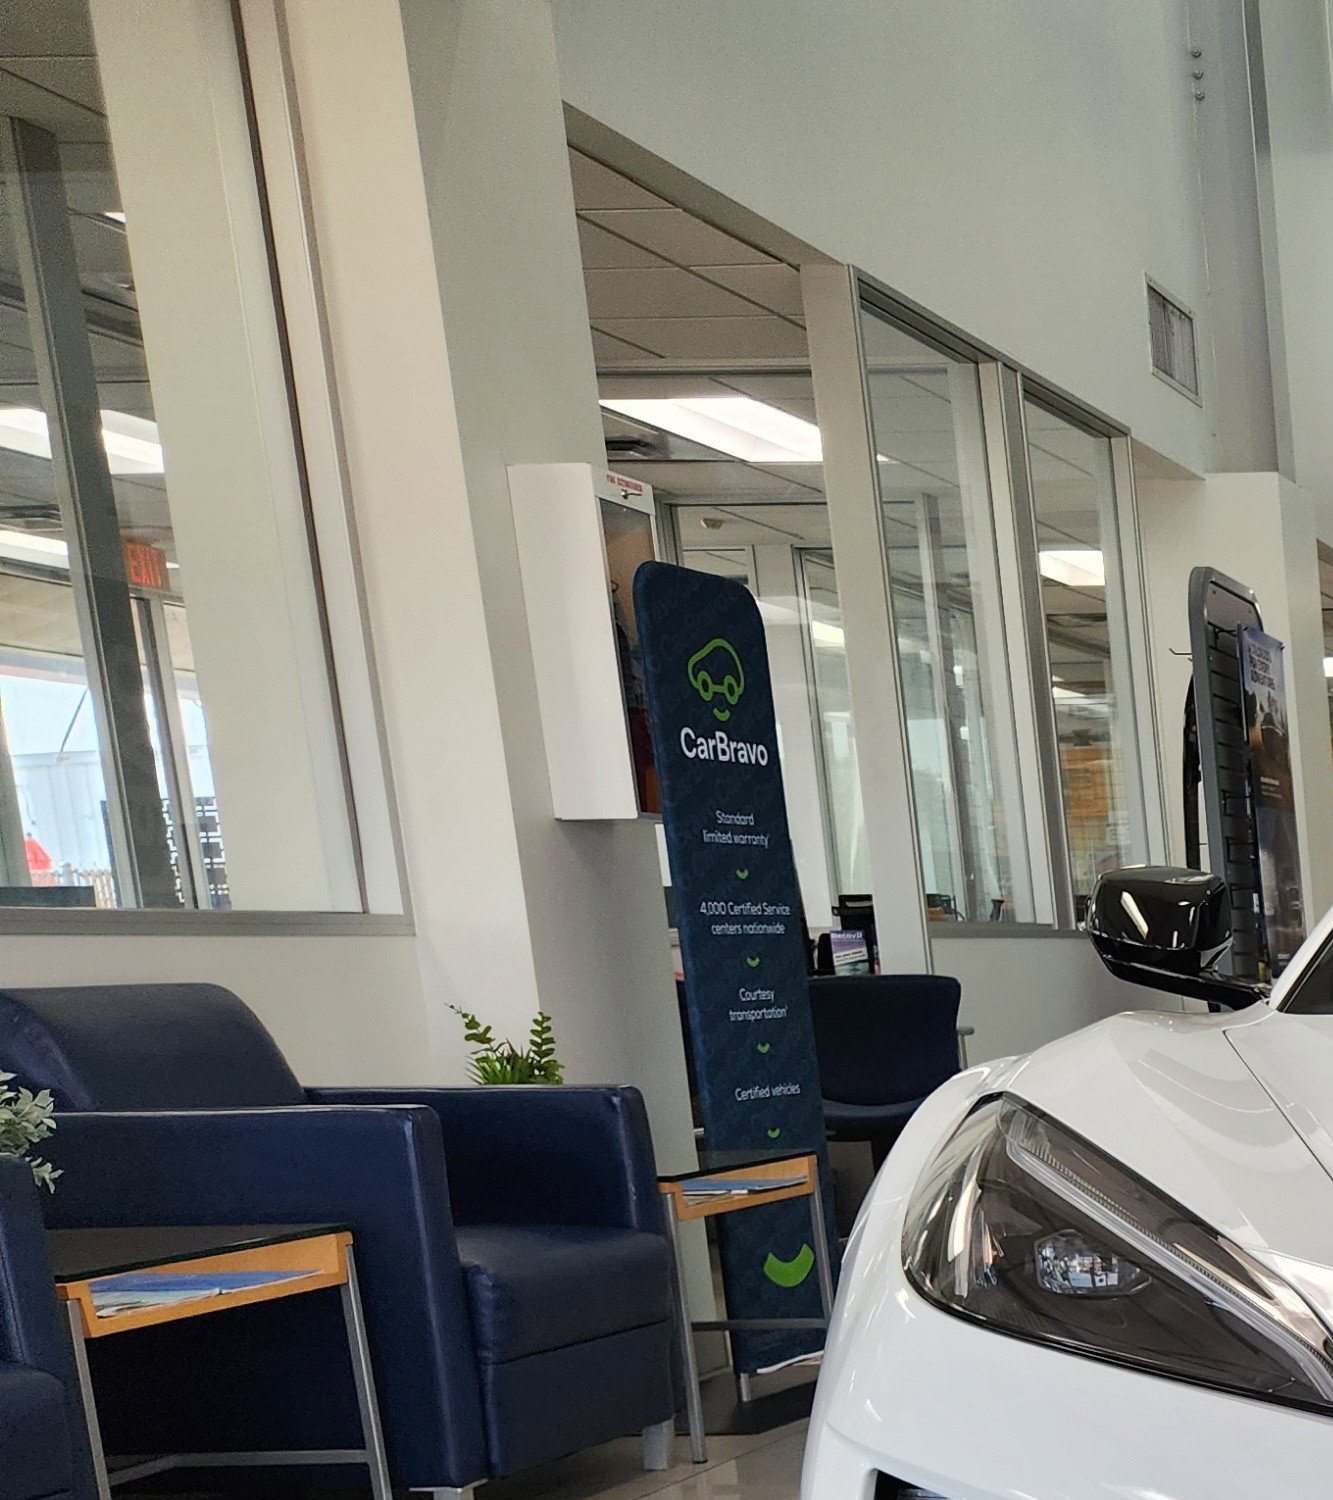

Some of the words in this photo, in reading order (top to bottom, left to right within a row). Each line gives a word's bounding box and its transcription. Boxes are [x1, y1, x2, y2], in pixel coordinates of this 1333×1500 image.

[126, 544, 162, 587] EXIT
[680, 726, 769, 766] CarBravo
[716, 810, 755, 826] Standard
[703, 829, 733, 844] limited
[700, 901, 726, 916] 4,000
[727, 901, 762, 916] Certified
[763, 901, 791, 916] Service
[711, 923, 742, 935] centers
[743, 921, 786, 935] nationwide
[739, 987, 775, 1003] Courtesy
[735, 1085, 771, 1101] Certified
[771, 1083, 801, 1097] vehicles
